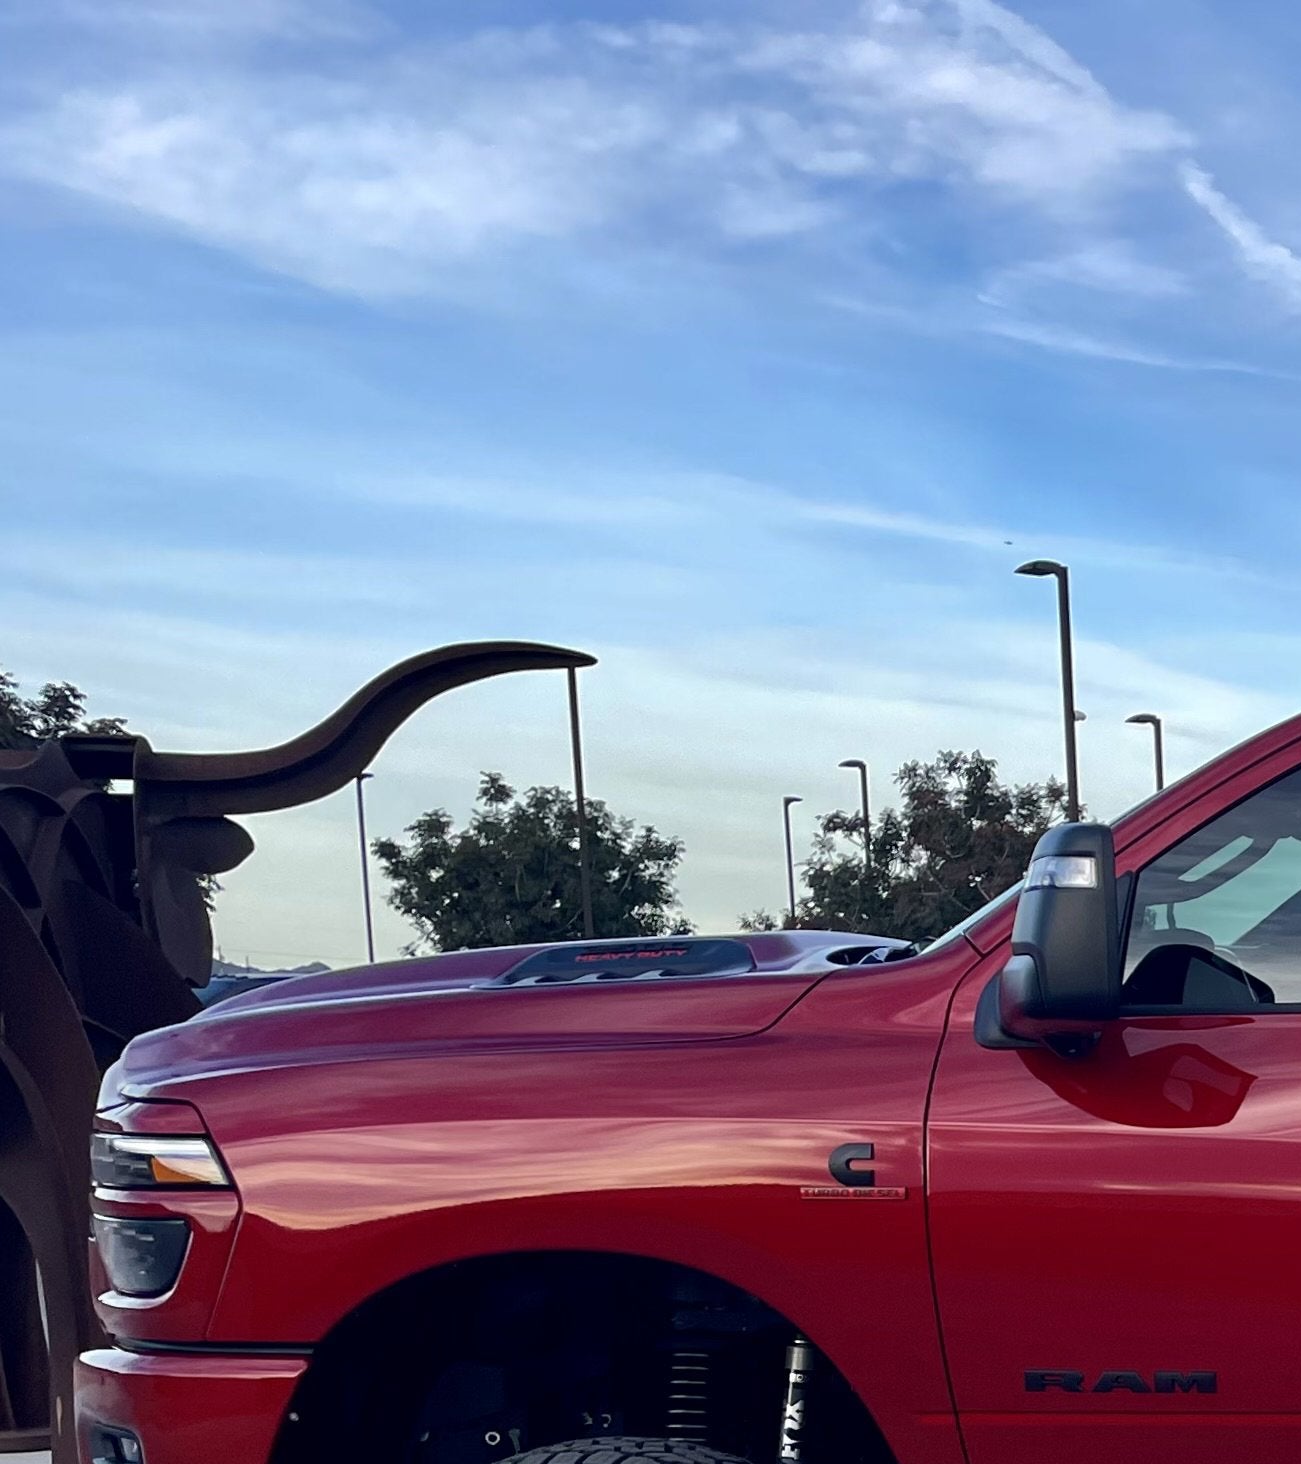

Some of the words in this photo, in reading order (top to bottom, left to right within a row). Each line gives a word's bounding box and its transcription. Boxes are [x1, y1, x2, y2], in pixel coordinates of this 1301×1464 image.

[575, 951, 634, 963] HEAVY
[635, 949, 688, 960] DUTY
[1023, 1368, 1218, 1394] RAM
[780, 1399, 806, 1461] FOX
